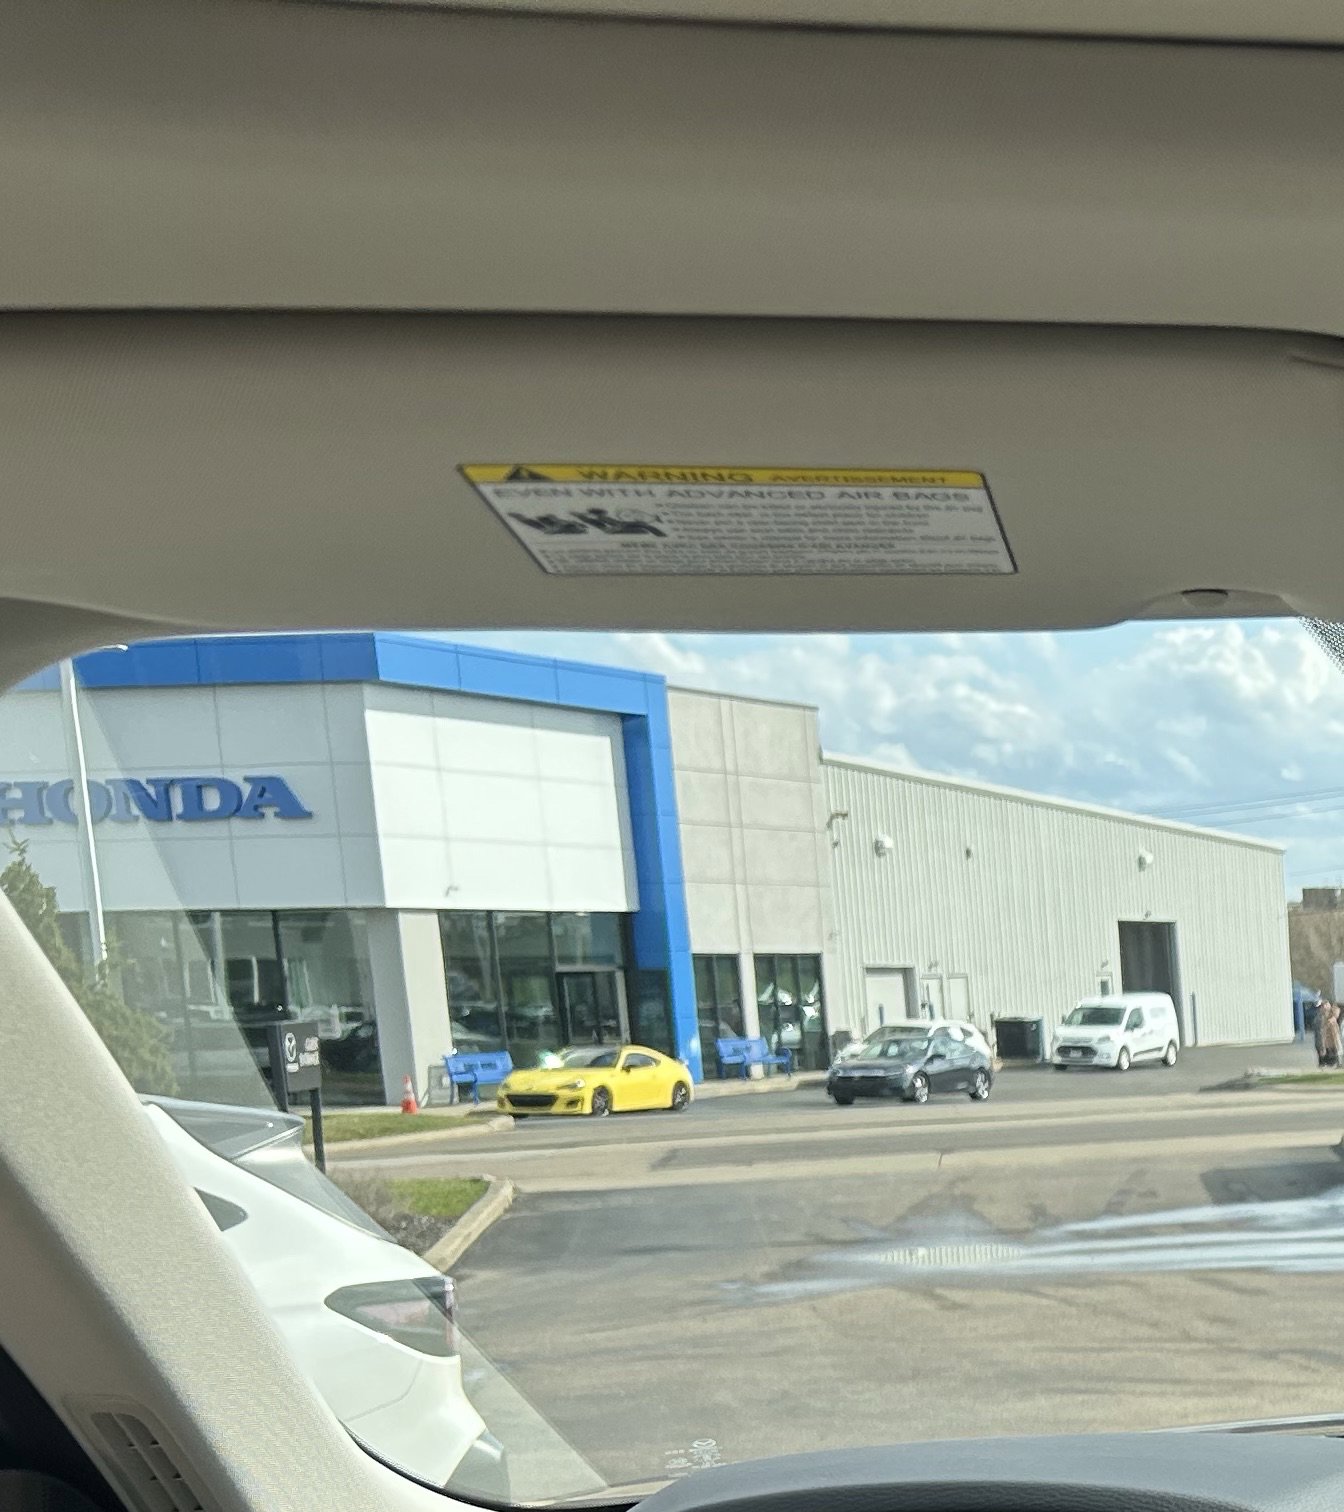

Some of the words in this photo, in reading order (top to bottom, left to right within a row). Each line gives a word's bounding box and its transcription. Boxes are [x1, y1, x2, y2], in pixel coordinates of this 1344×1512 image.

[577, 467, 753, 483] WARNING
[770, 474, 947, 485] AVERTISSEMENT
[493, 487, 572, 498] EVEN
[578, 487, 656, 499] WITH
[667, 487, 826, 500] ADVANCED
[838, 490, 882, 501] AIR
[892, 490, 970, 502] BAGS
[0, 774, 313, 826] HONDA
